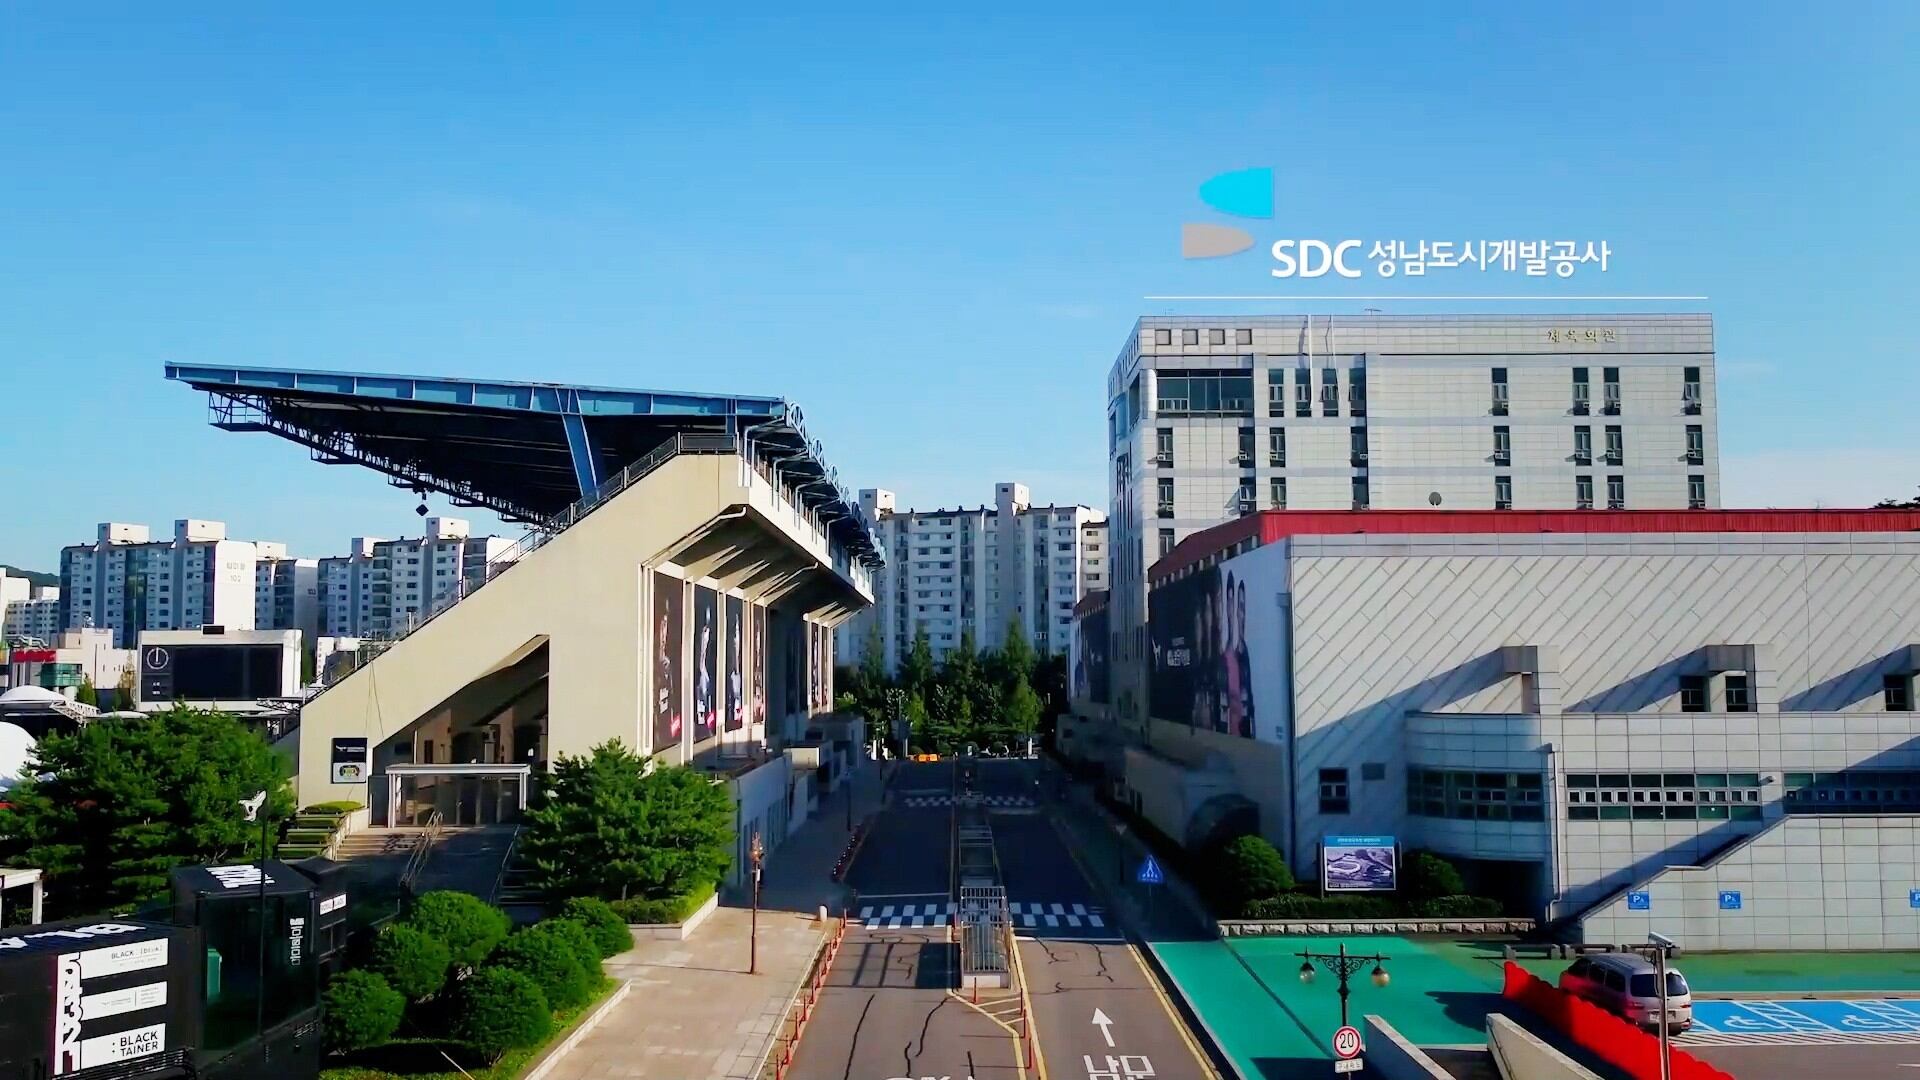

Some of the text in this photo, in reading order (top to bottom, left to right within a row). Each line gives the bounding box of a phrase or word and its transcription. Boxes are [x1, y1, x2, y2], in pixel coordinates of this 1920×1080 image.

[120, 1030, 158, 1047] BLACK
[1340, 1032, 1354, 1049] 20
[120, 1041, 158, 1057] TAINER
